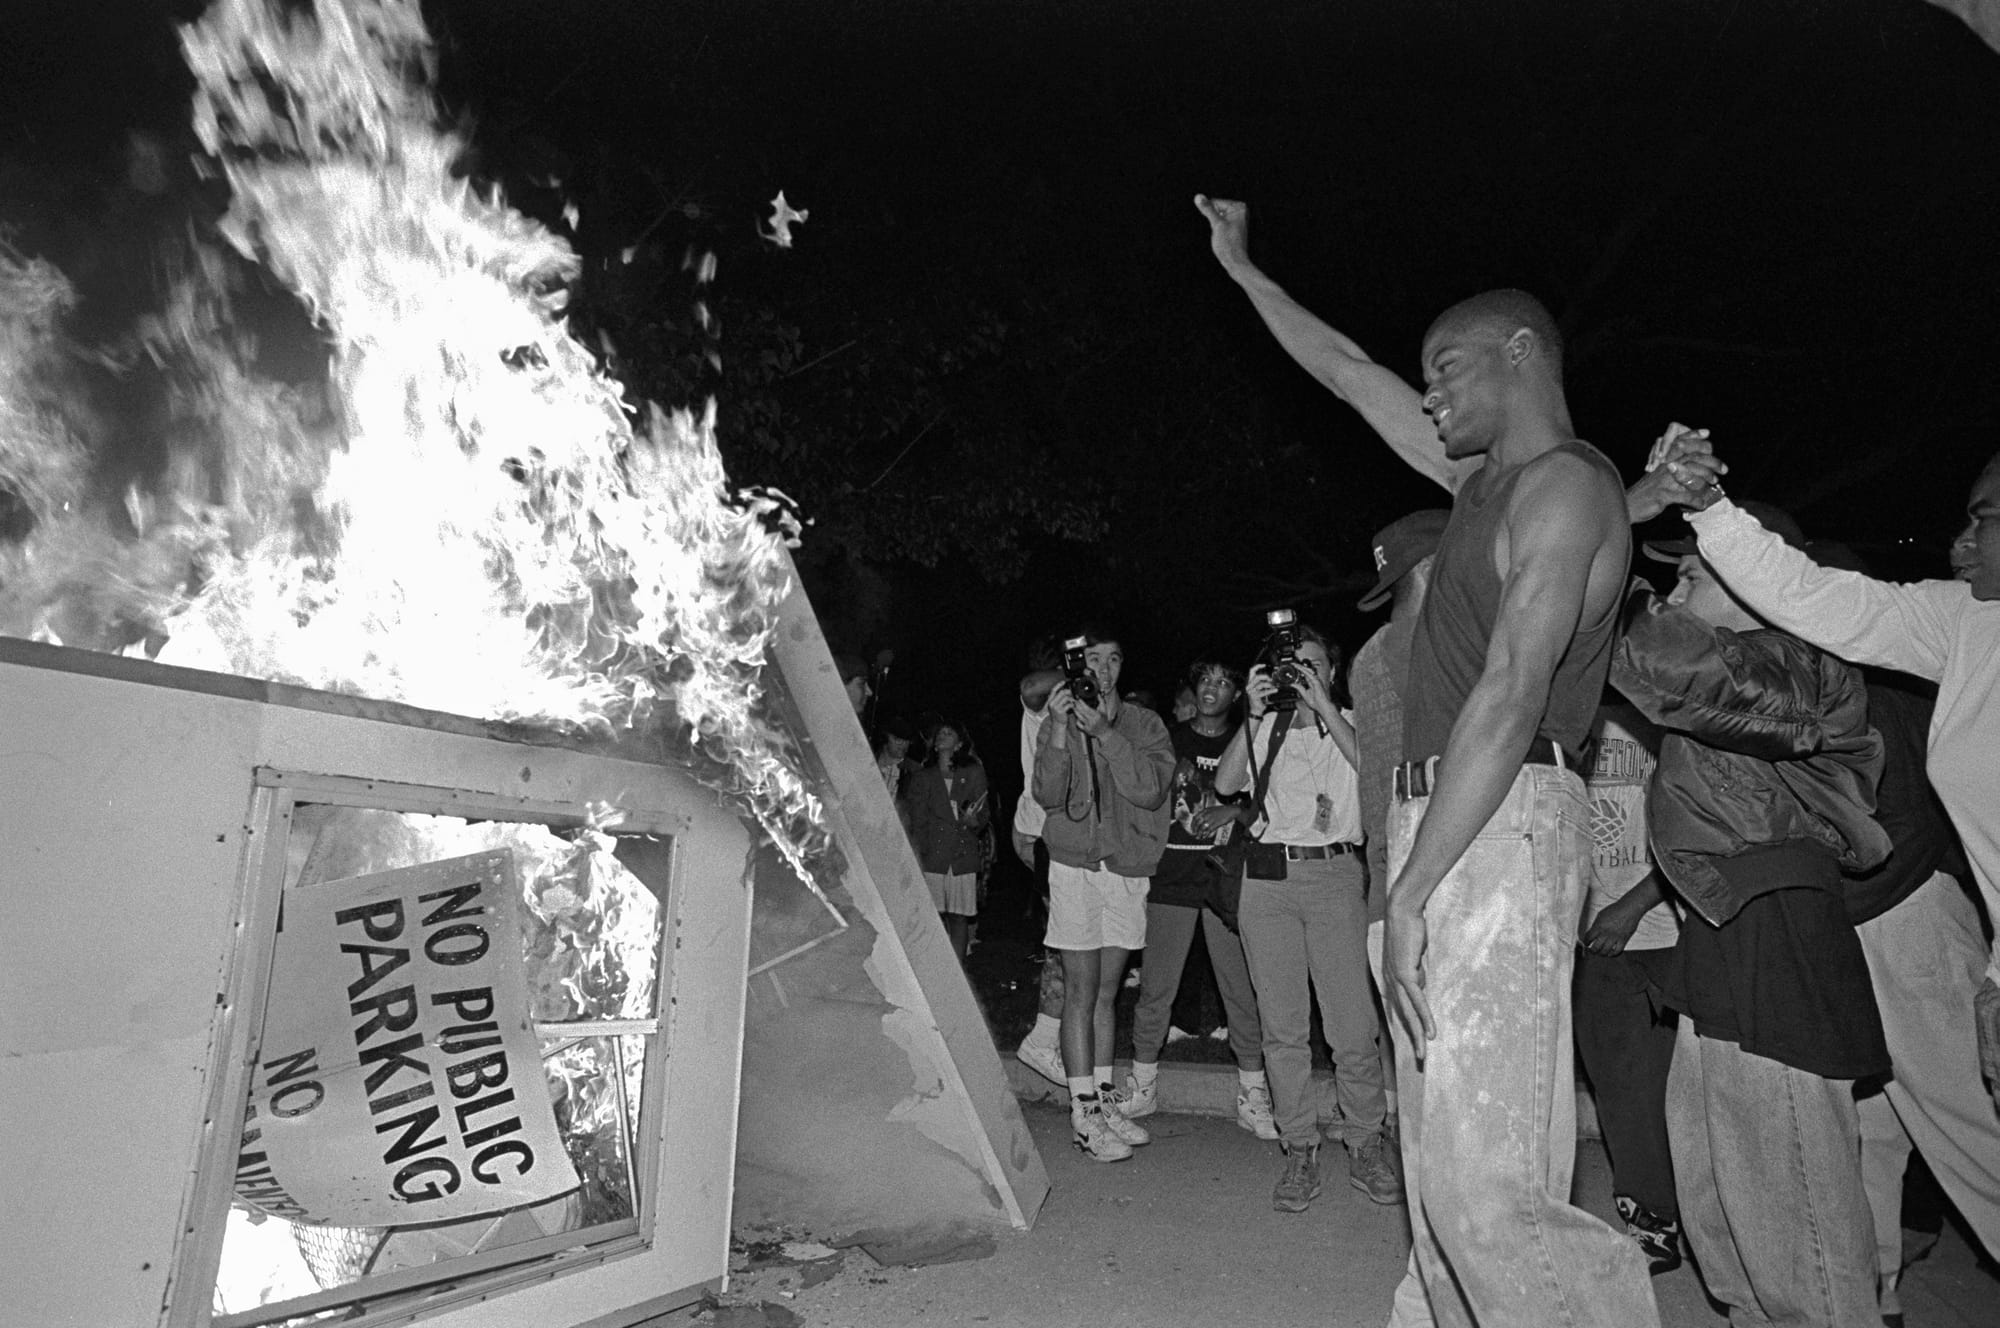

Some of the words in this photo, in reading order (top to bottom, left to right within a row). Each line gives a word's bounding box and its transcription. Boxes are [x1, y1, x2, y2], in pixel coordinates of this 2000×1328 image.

[418, 881, 490, 966] NO
[263, 1047, 325, 1118] NO
[335, 898, 461, 1204] PARKING
[431, 986, 534, 1185] PUBLIC
